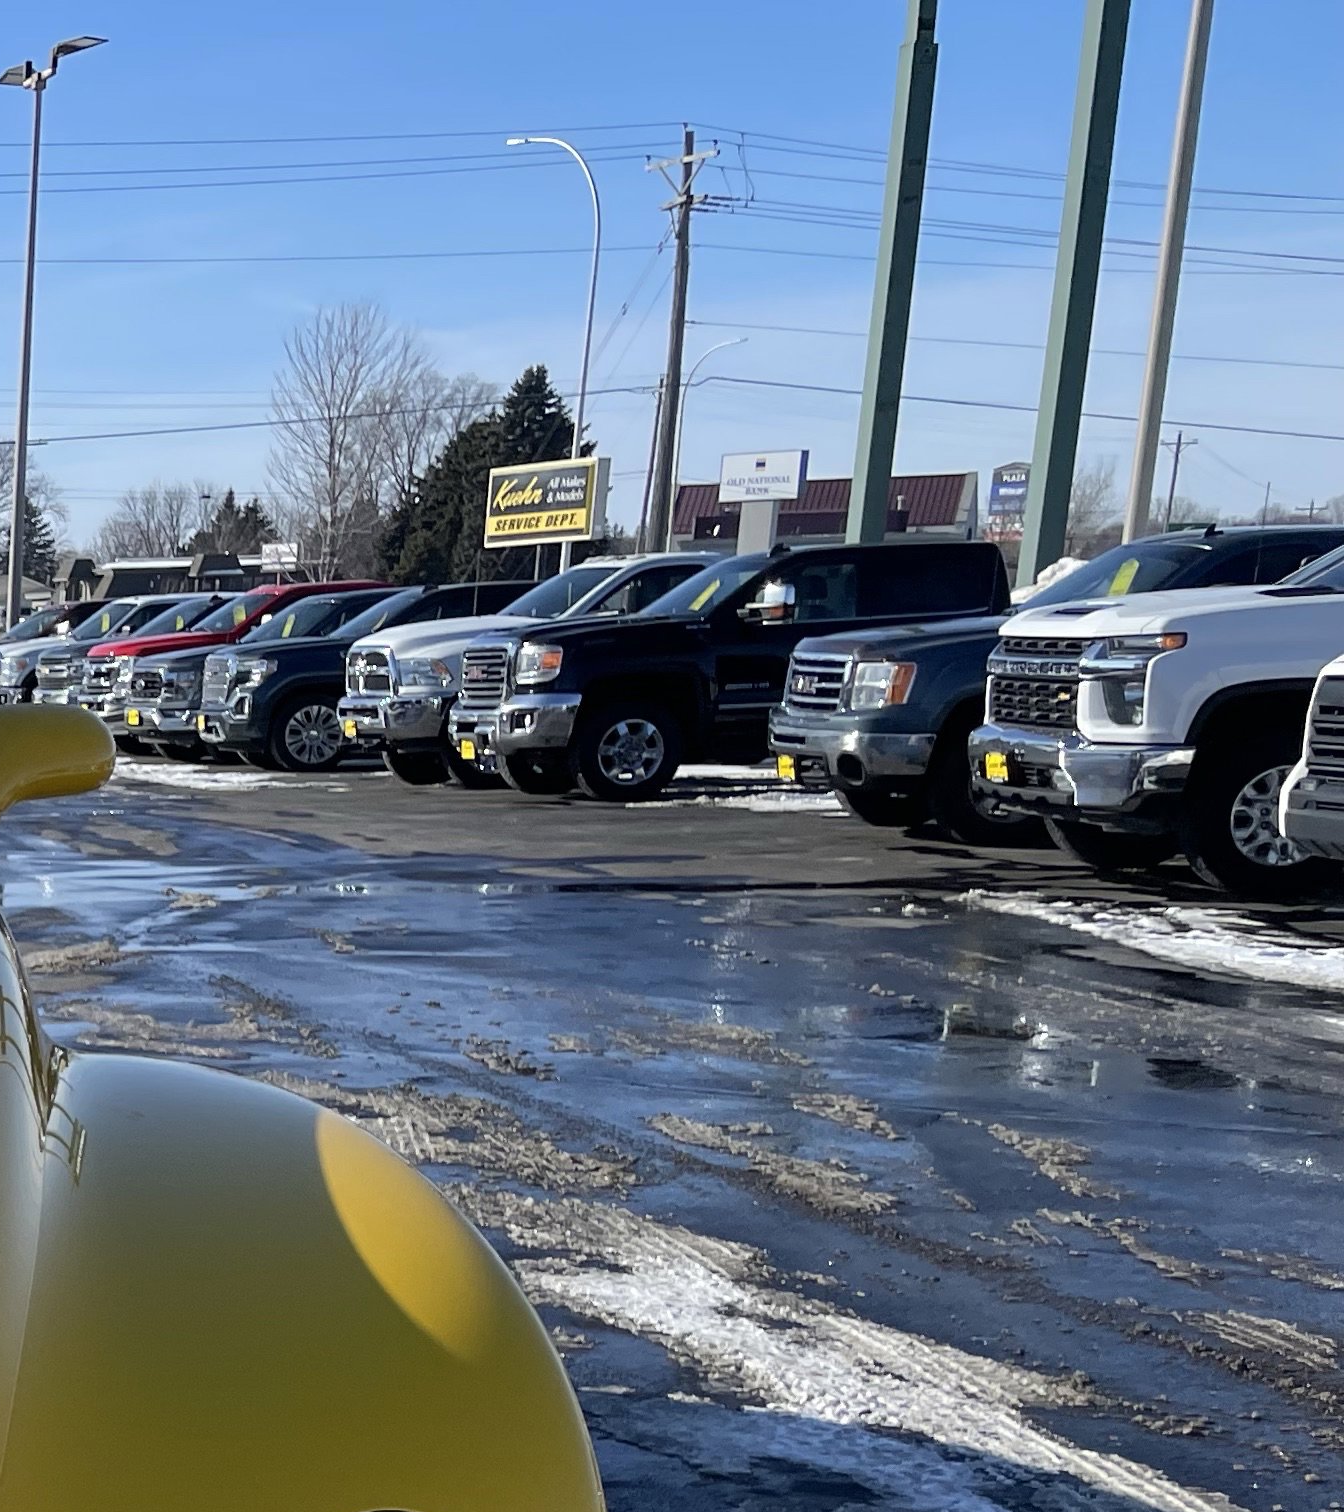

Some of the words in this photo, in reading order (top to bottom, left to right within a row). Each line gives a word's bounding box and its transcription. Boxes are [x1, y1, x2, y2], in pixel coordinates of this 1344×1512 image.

[726, 478, 746, 487] OLD
[747, 475, 791, 486] NATIONAL
[1002, 473, 1026, 482] PLAZA
[492, 475, 543, 512] Kuehn
[745, 487, 769, 496] BANK
[494, 515, 543, 532] SERVICE
